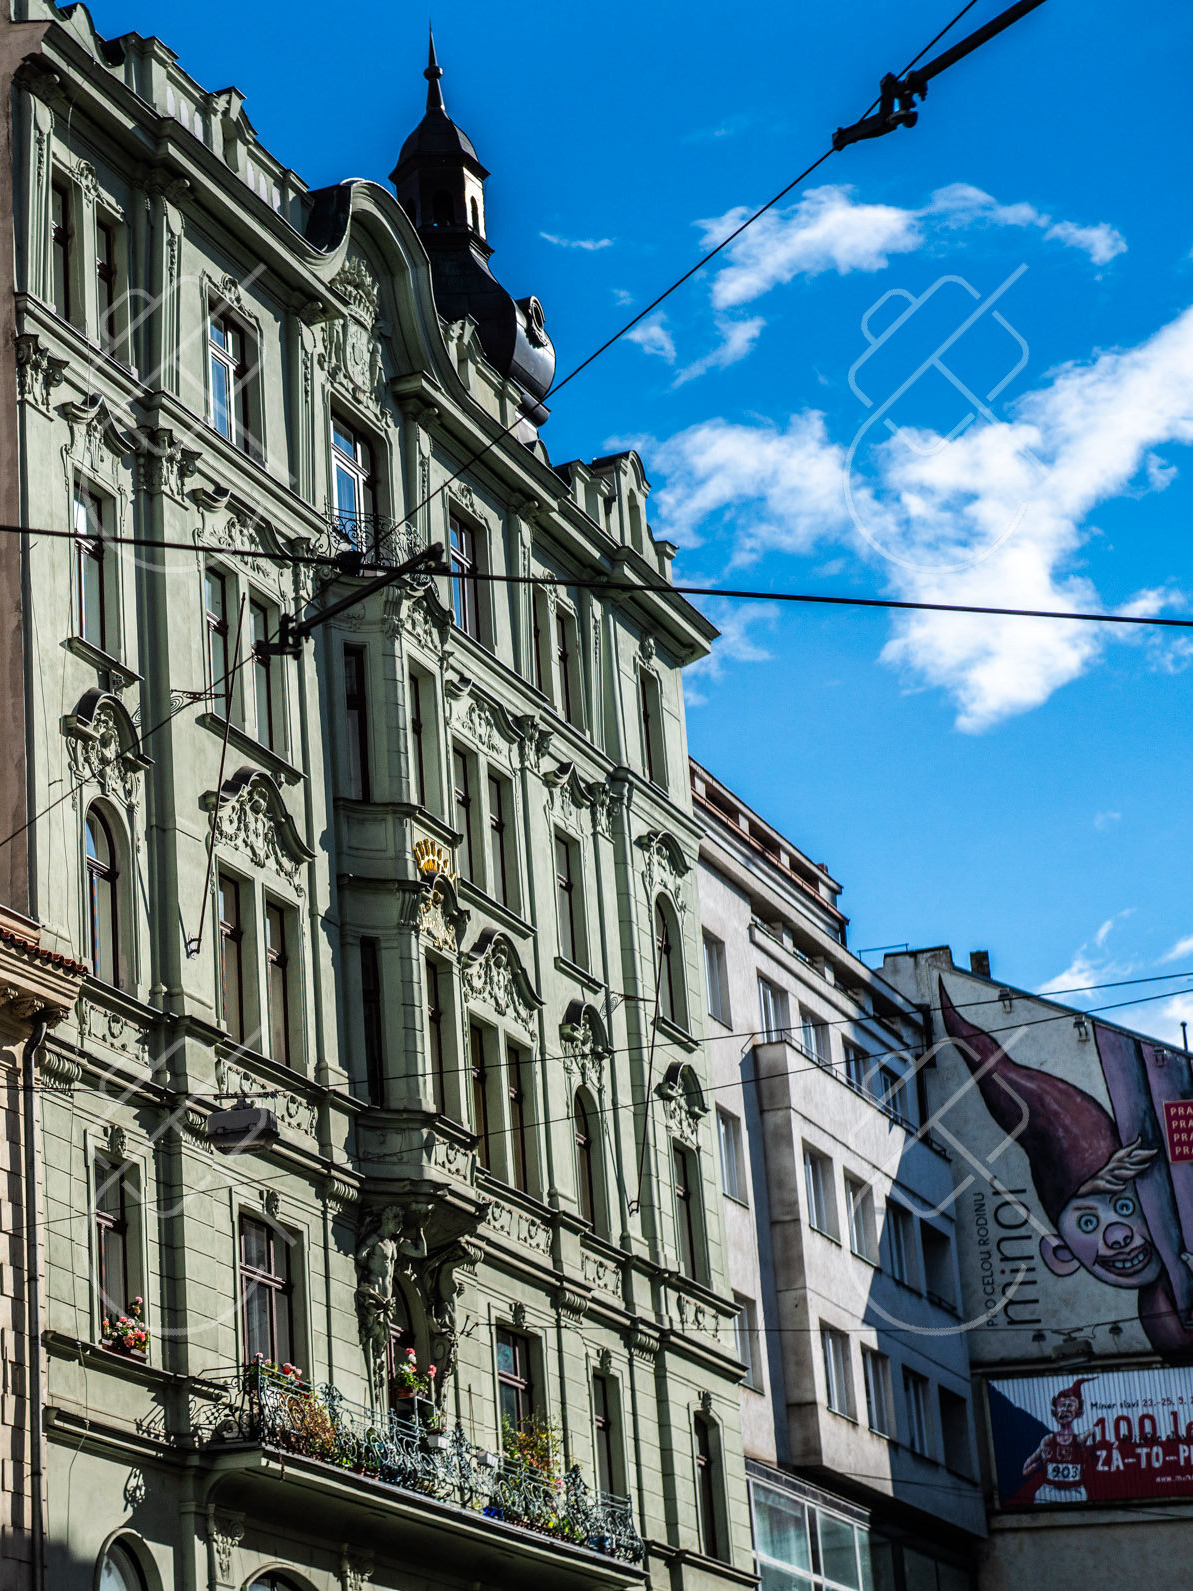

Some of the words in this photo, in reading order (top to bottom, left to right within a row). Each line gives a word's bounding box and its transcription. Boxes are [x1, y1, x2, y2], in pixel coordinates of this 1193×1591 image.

[1175, 1145, 1193, 1156] PR
[973, 1192, 990, 1247] RODINU
[992, 1175, 1042, 1326] minor
[980, 1250, 995, 1296] CELOU
[1093, 1413, 1157, 1443] 100
[1052, 1464, 1079, 1479] 903
[1096, 1441, 1193, 1472] ZÁ-TO-P
